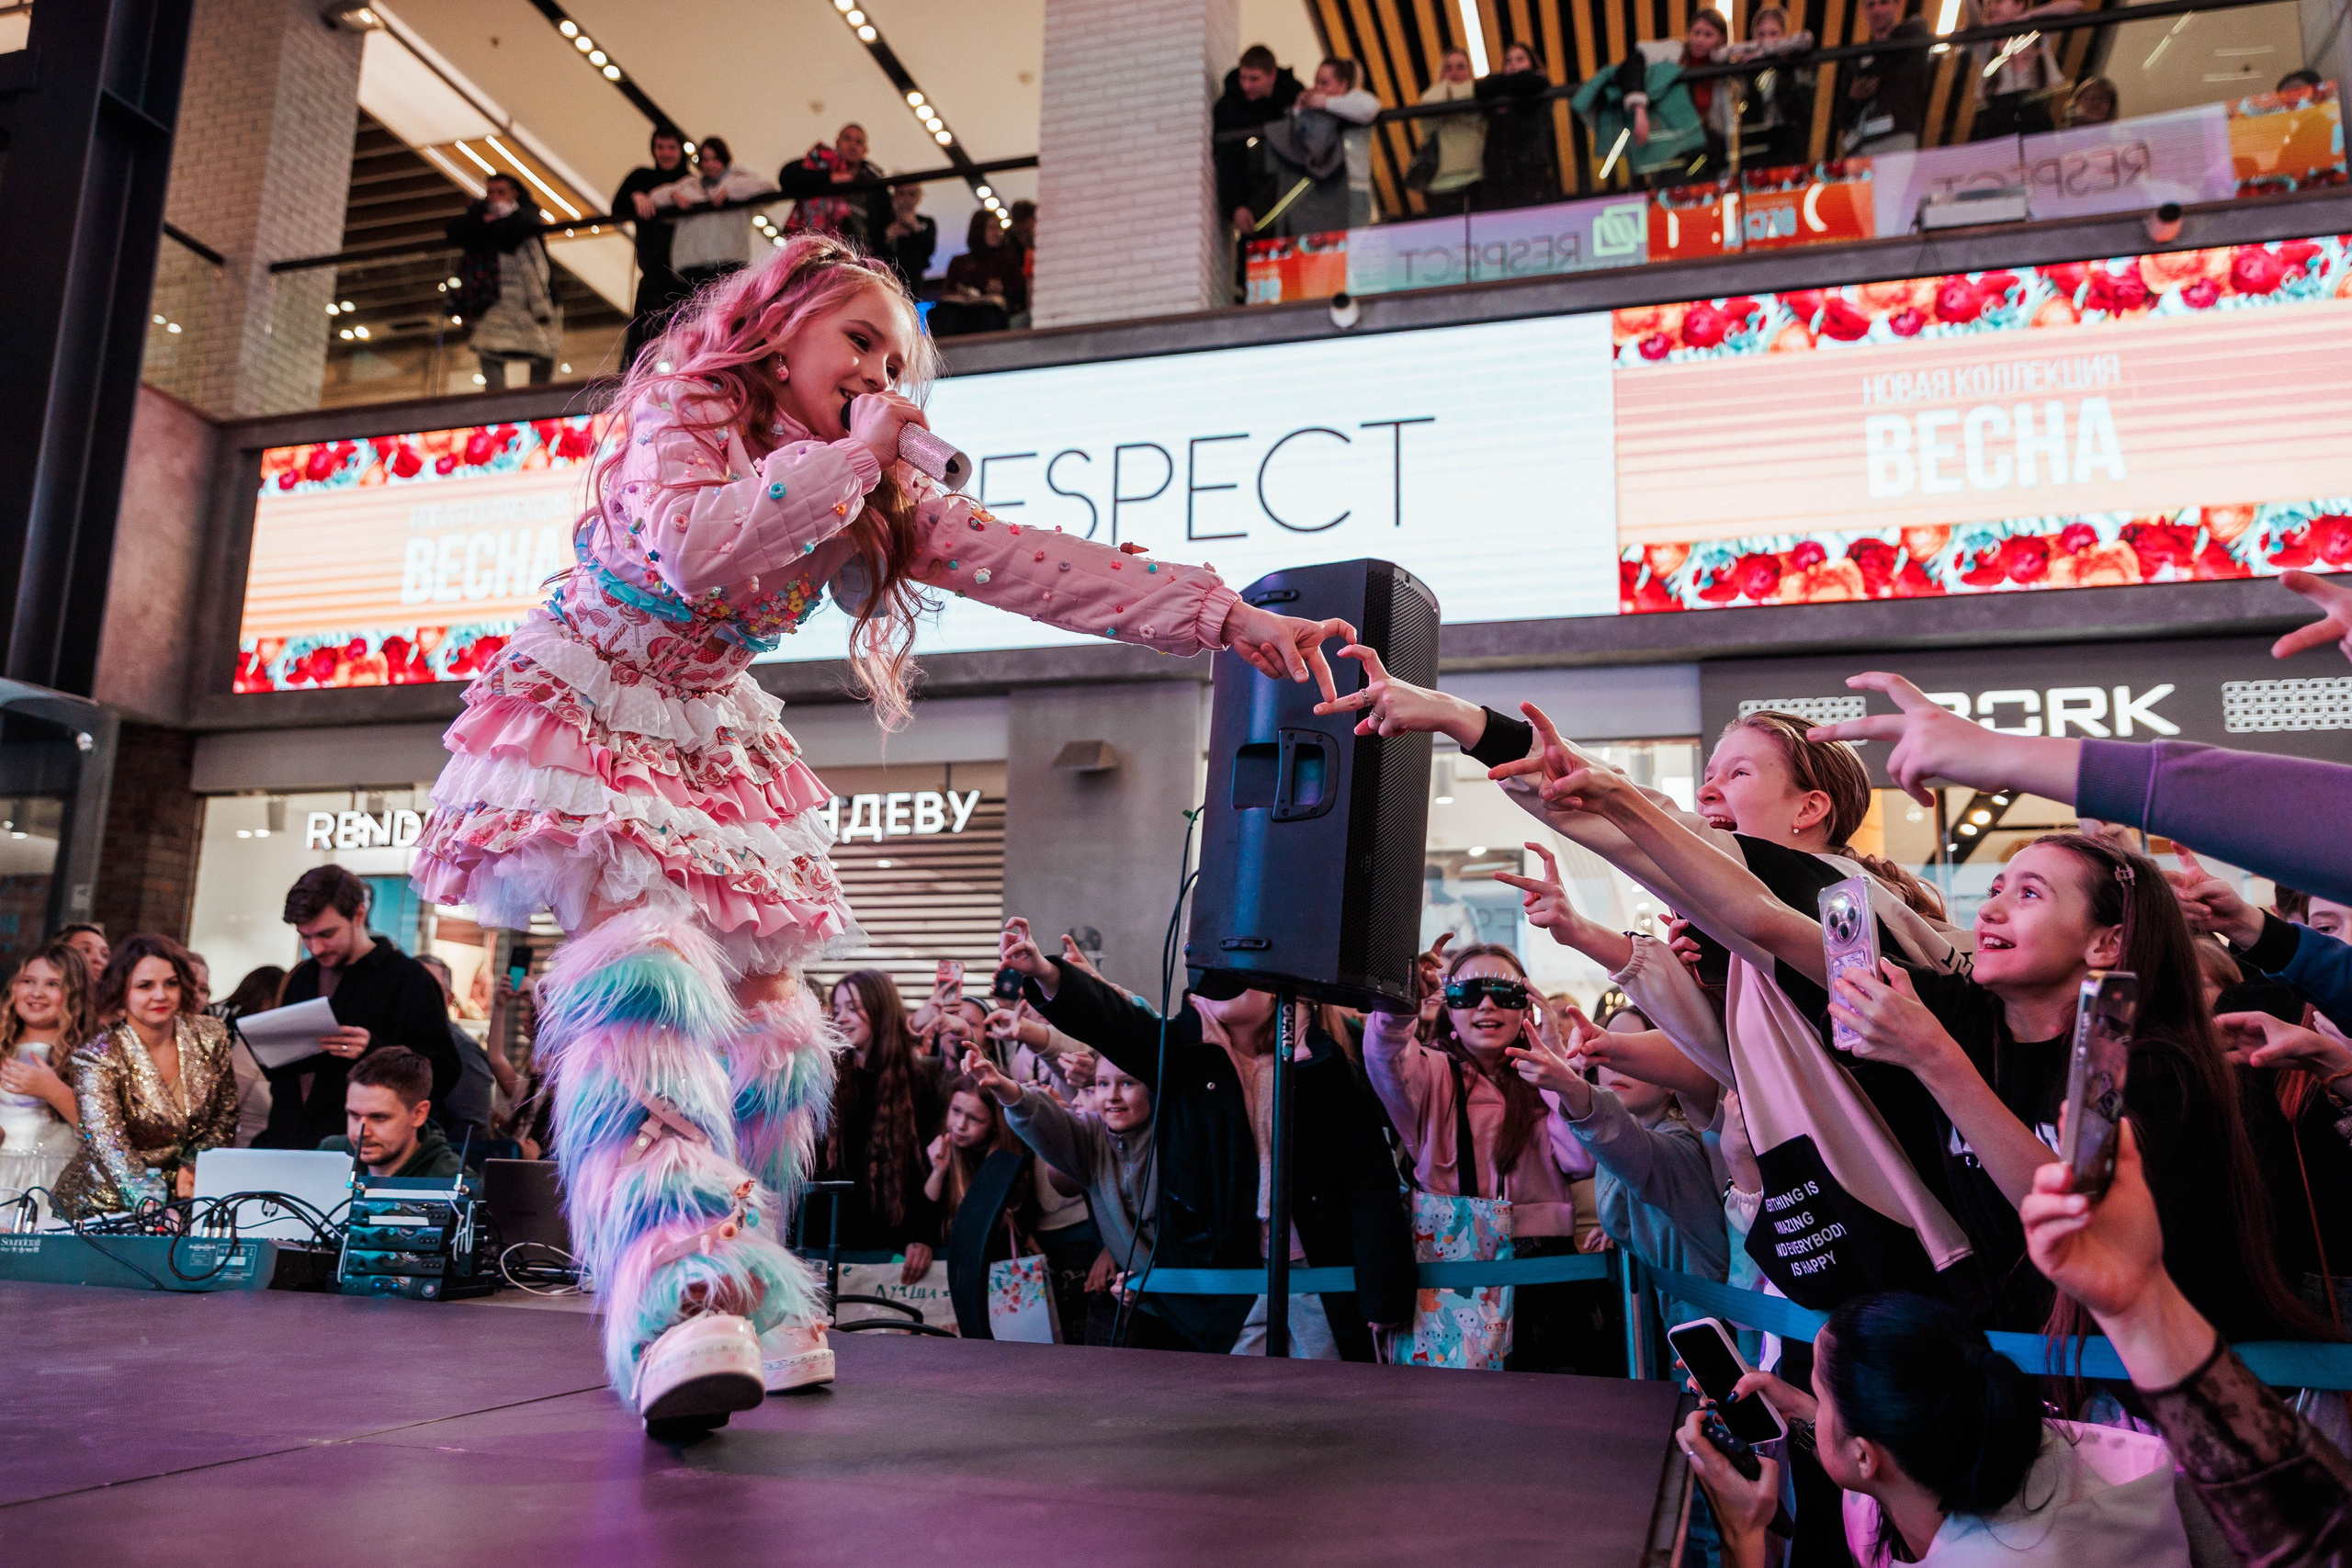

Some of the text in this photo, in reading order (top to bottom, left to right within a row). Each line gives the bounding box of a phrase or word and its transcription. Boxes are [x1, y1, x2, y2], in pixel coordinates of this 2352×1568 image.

[1862, 369, 1951, 406] НОВАЯ
[1864, 396, 2128, 499] ВЕСНА
[979, 416, 1437, 546] ESPECT
[401, 525, 560, 605] ВЕСНА
[305, 808, 434, 851] REND
[818, 789, 981, 844] НДЕВУ
[1804, 1180, 1820, 1196] IS
[1774, 1211, 1815, 1235] AMAZING
[1775, 1243, 1789, 1258] ND
[1791, 1250, 1837, 1277] IS HAPPY
